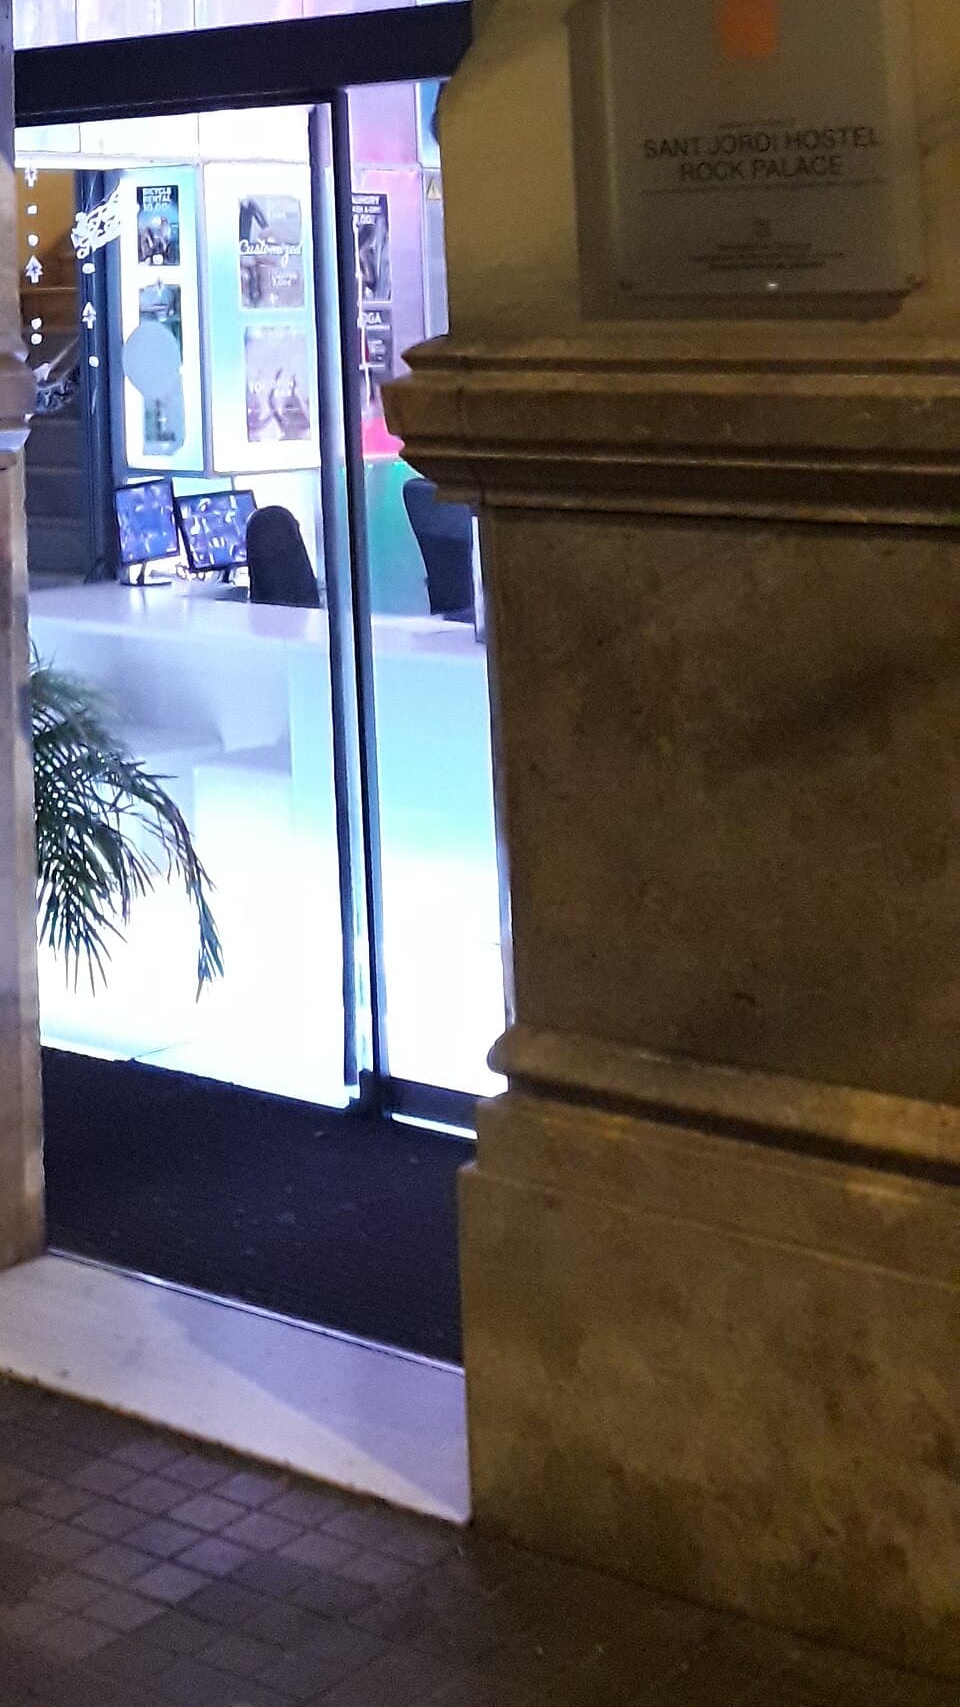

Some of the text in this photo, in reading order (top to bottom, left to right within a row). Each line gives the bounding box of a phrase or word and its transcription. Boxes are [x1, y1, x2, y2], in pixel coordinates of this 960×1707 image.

[644, 126, 878, 159] SANT JORDI HOSTEL
[679, 155, 843, 182] ROCK PALACE
